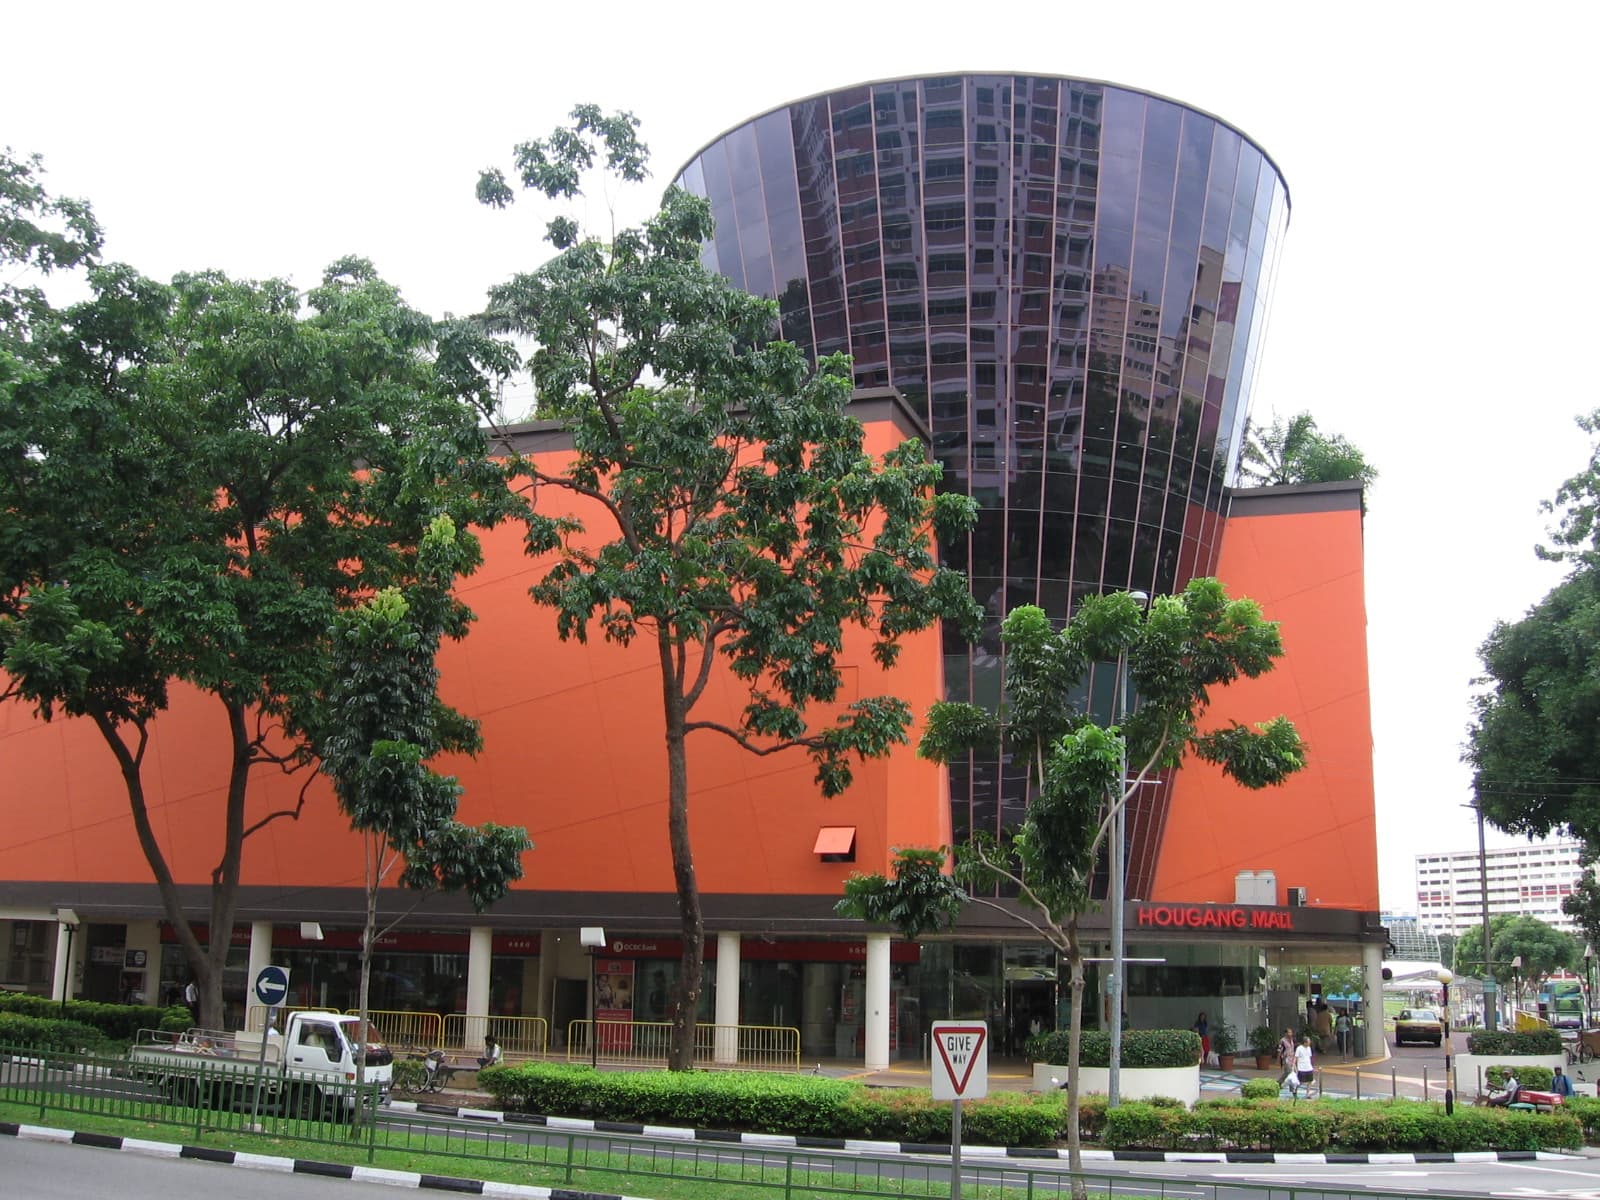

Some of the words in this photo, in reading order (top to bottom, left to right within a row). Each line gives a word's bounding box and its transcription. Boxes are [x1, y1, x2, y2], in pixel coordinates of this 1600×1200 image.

[1139, 906, 1246, 928] HOUGANG
[1252, 910, 1294, 928] MALL
[1362, 965, 1370, 1030] TAXI
[947, 1036, 971, 1051] GIVE
[953, 1054, 966, 1064] WAY
